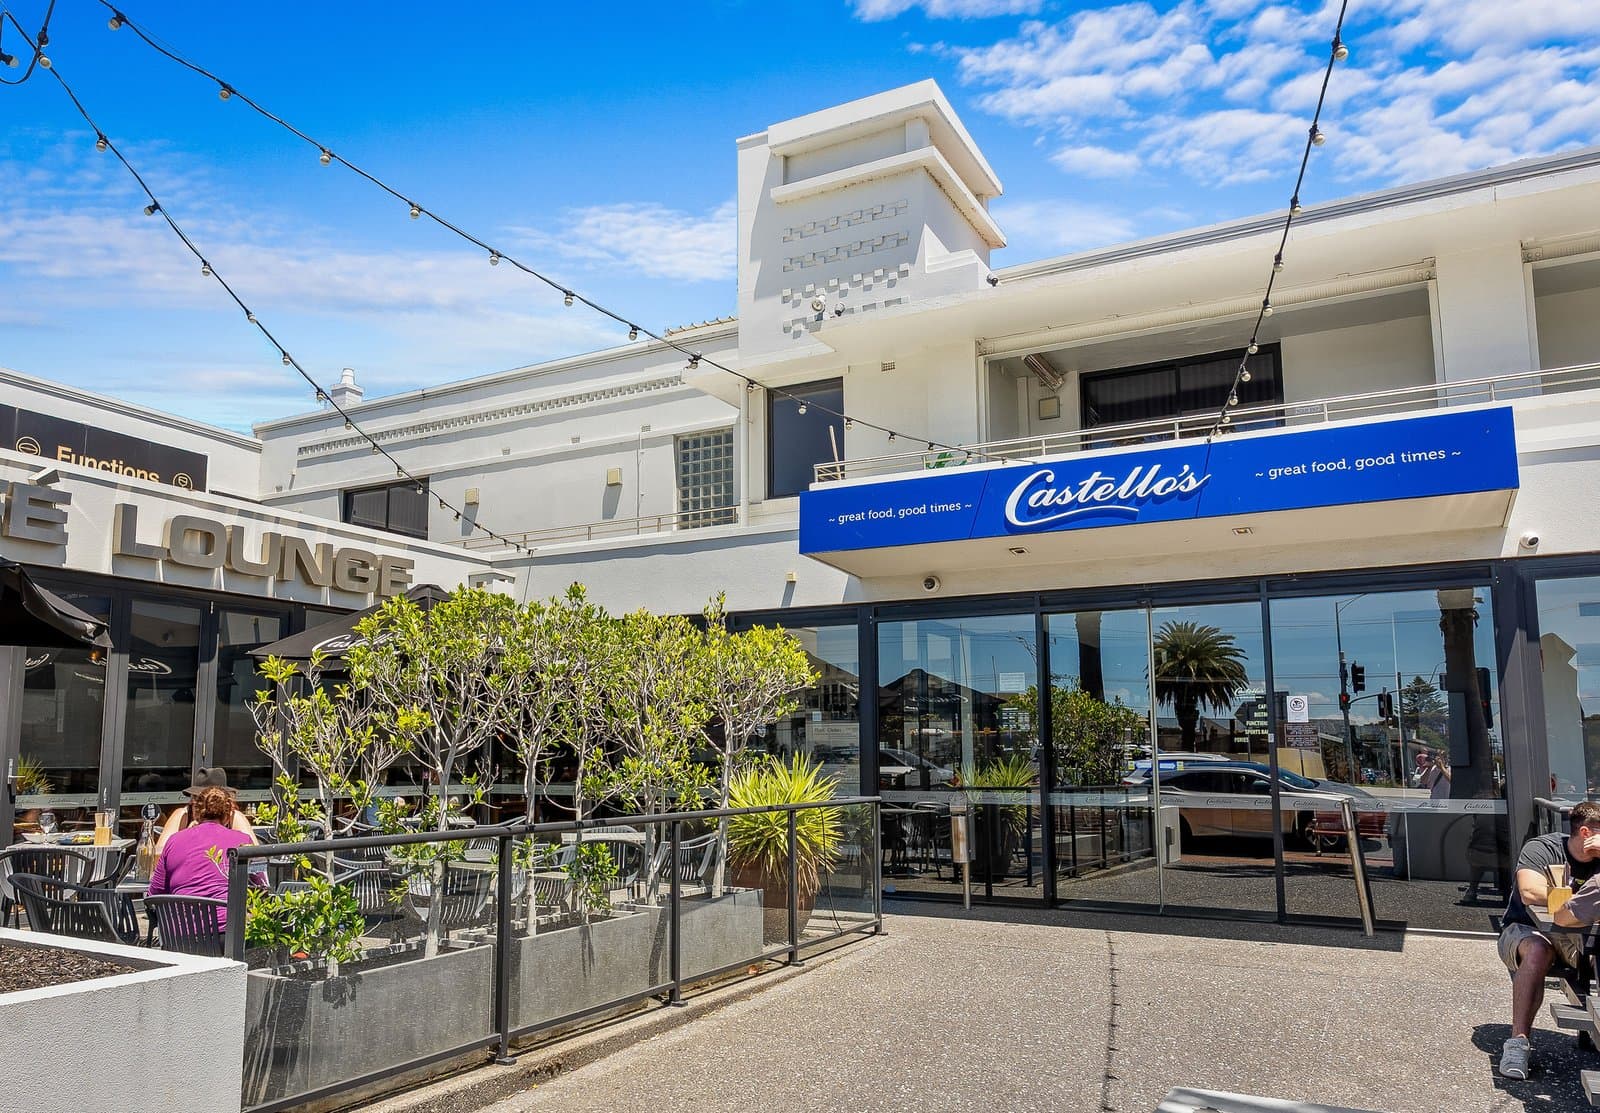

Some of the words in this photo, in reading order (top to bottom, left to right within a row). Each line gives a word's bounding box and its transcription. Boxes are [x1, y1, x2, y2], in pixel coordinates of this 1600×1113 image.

[57, 444, 160, 483] Functions
[1268, 463, 1307, 480] great
[1311, 458, 1352, 473] food,
[1355, 452, 1395, 471] good
[1400, 449, 1446, 463] times
[838, 511, 865, 525] great
[868, 507, 896, 520] food,
[898, 504, 927, 518] good
[930, 502, 962, 513] times
[1005, 464, 1212, 526] Castello's
[112, 503, 415, 597] LOUNGE
